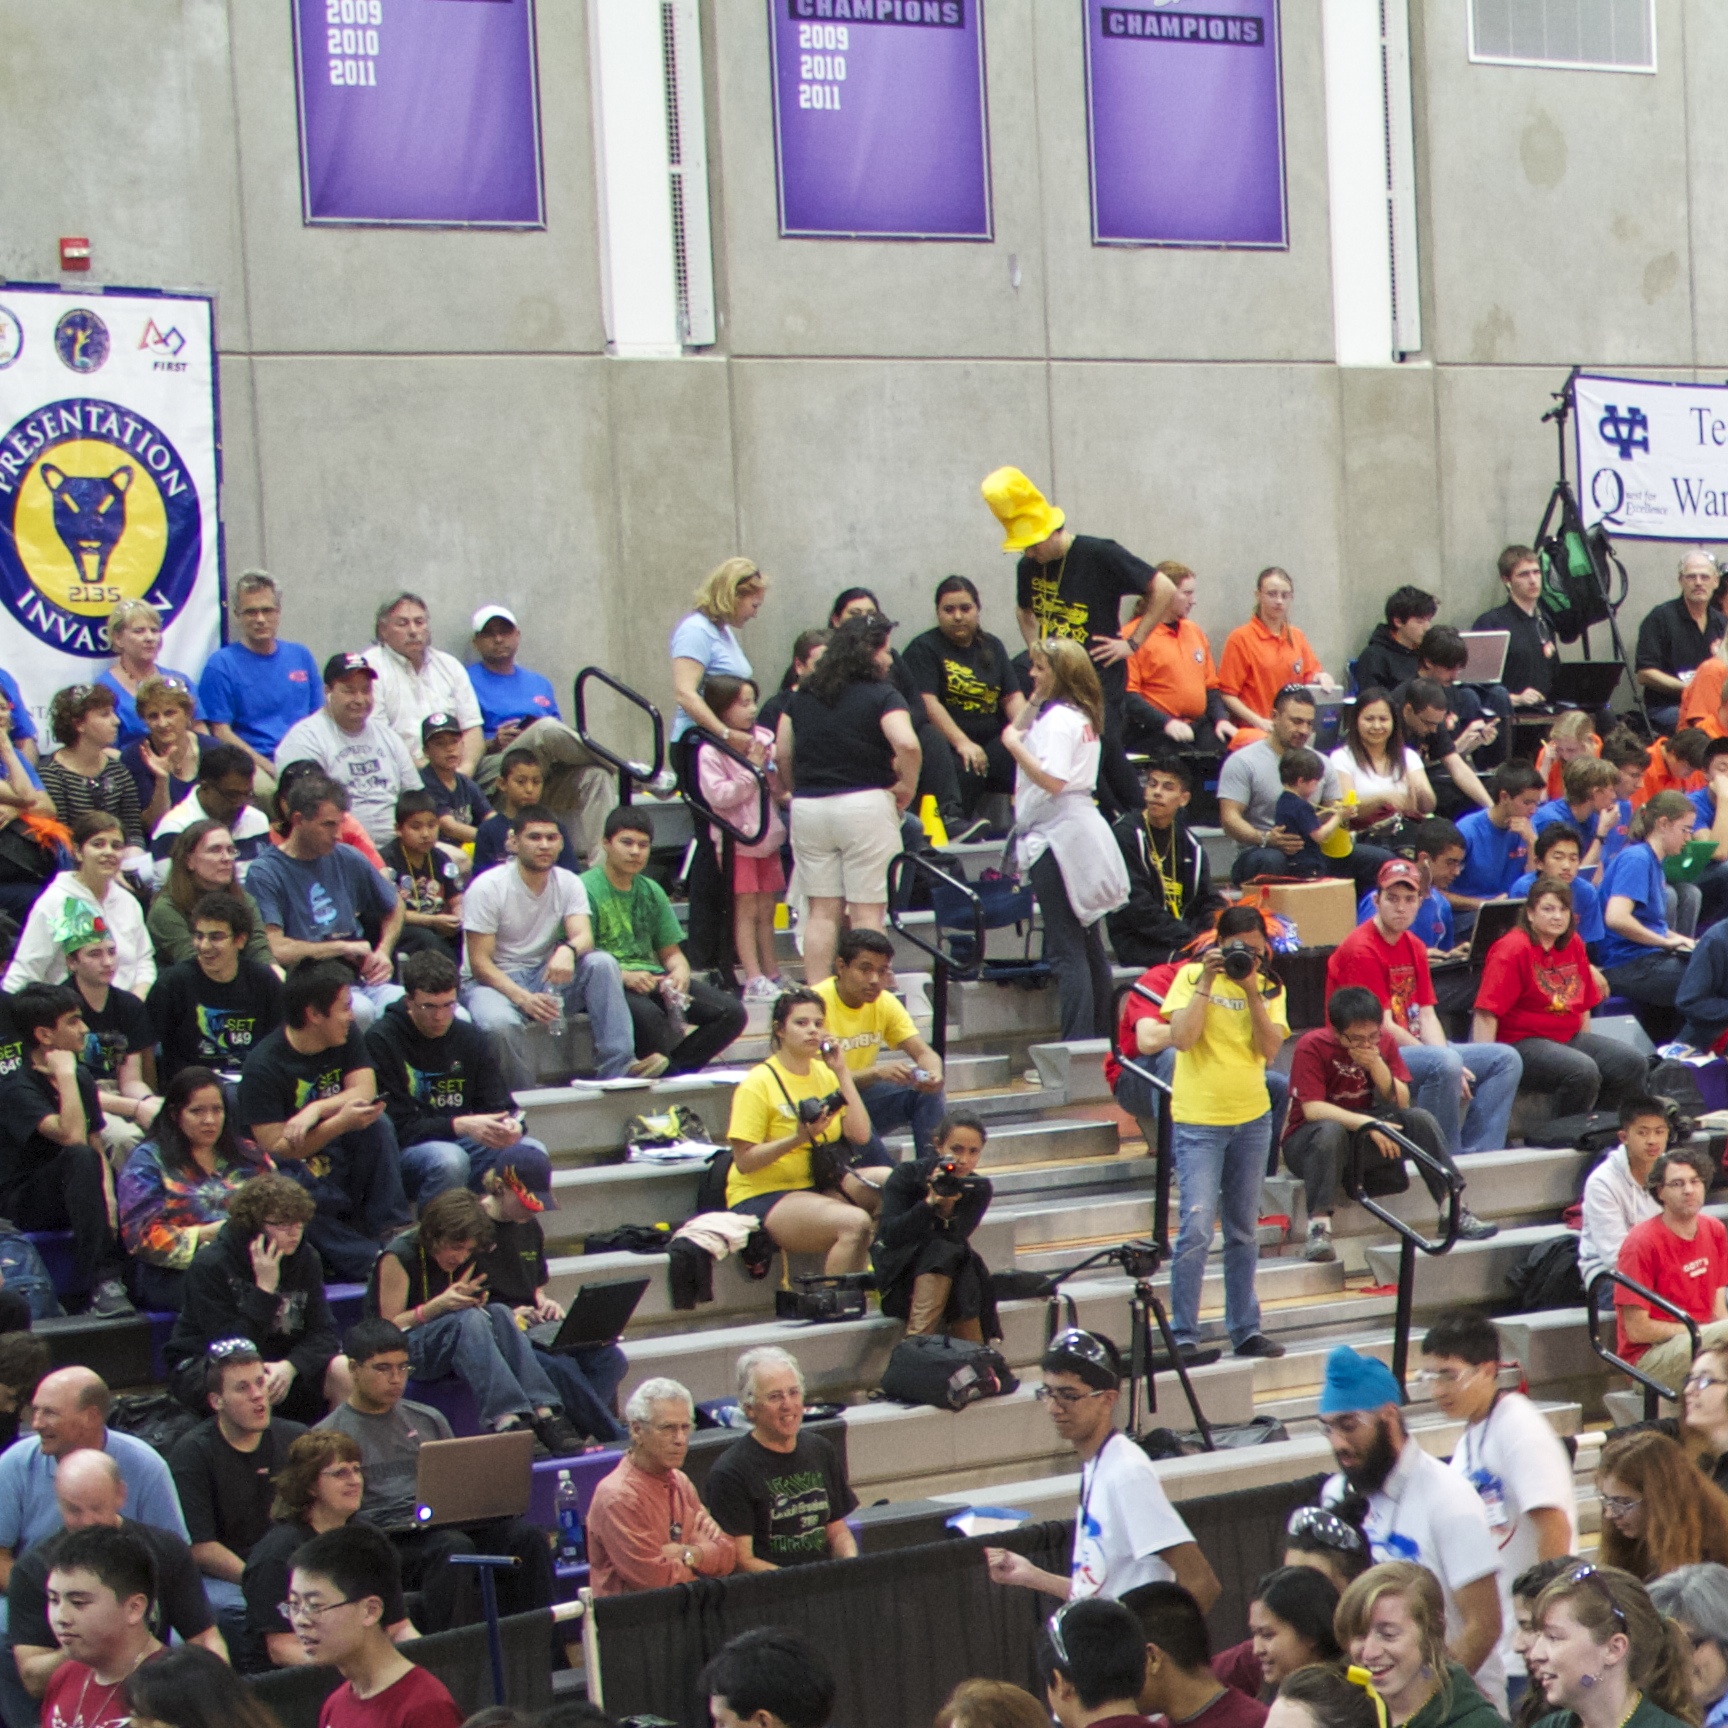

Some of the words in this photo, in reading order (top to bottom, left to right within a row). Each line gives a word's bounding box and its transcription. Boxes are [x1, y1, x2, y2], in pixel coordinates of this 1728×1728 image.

[327, 0, 382, 26] 2009
[796, 0, 960, 23] CHAMPIONS
[799, 25, 849, 51] 2009
[1109, 12, 1259, 44] CHAMPIONS
[327, 29, 380, 56] 2010
[329, 59, 377, 87] 2011
[800, 55, 847, 81] 2010
[798, 84, 842, 111] 2011
[153, 361, 189, 373] FIRST
[0, 405, 189, 498] PRESENTATION
[68, 586, 122, 602] 2135
[17, 587, 174, 654] INVASN
[436, 1092, 464, 1108] 649
